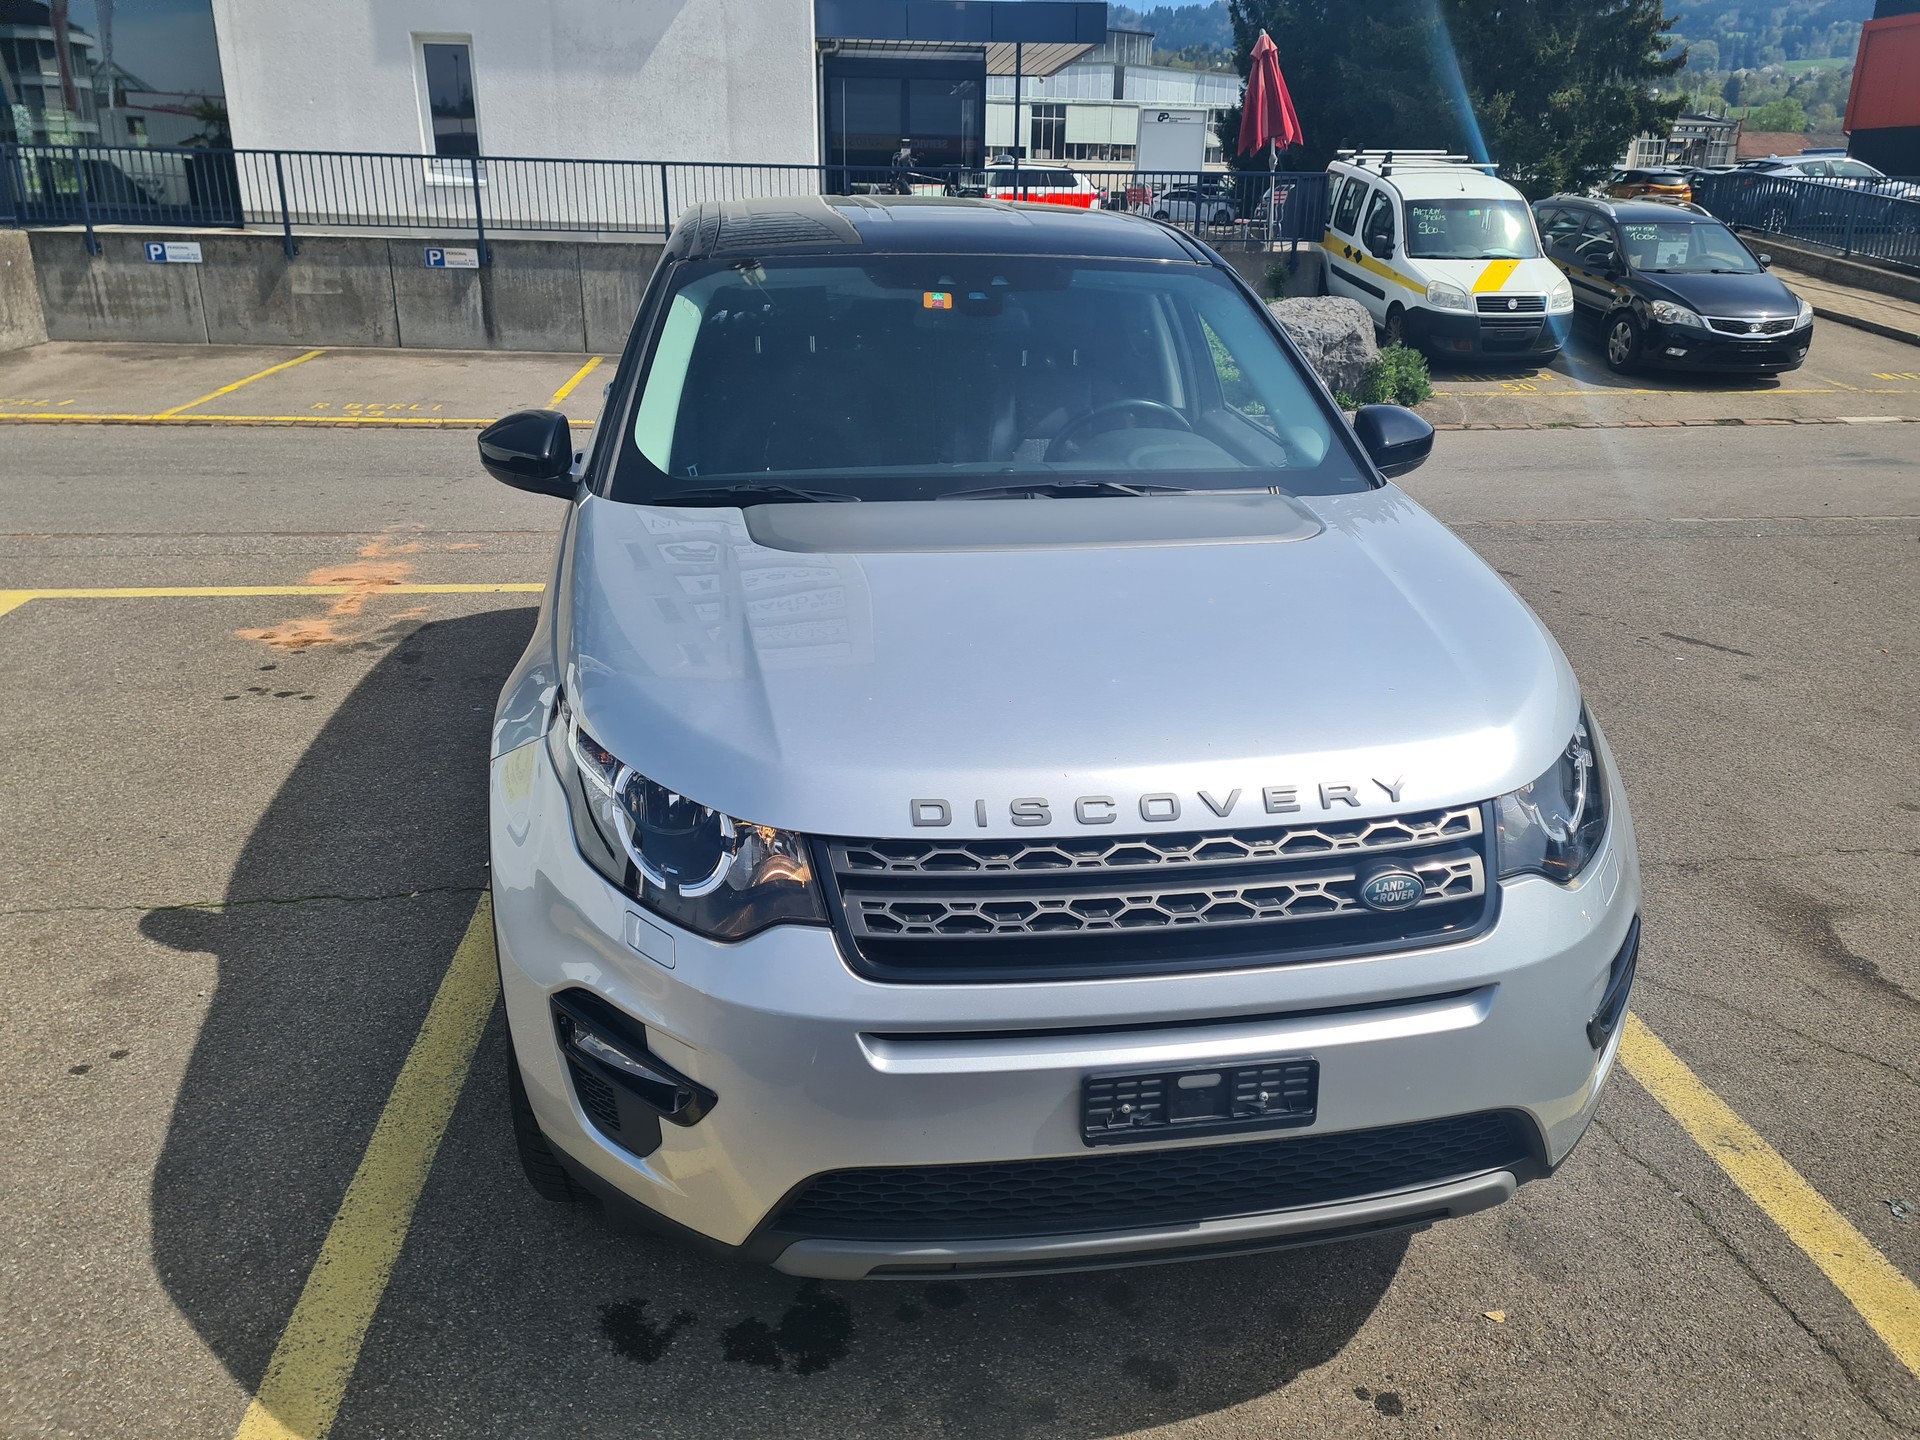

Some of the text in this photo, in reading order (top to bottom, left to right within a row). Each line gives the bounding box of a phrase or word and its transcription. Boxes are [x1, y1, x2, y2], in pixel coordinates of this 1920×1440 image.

[149, 244, 163, 260] P
[429, 250, 442, 266] P
[1871, 372, 1920, 381] MIE
[1501, 383, 1539, 392] 50
[910, 774, 1406, 828] DISCOVERY
[1375, 880, 1404, 893] LAND
[1380, 889, 1415, 903] ROVER
